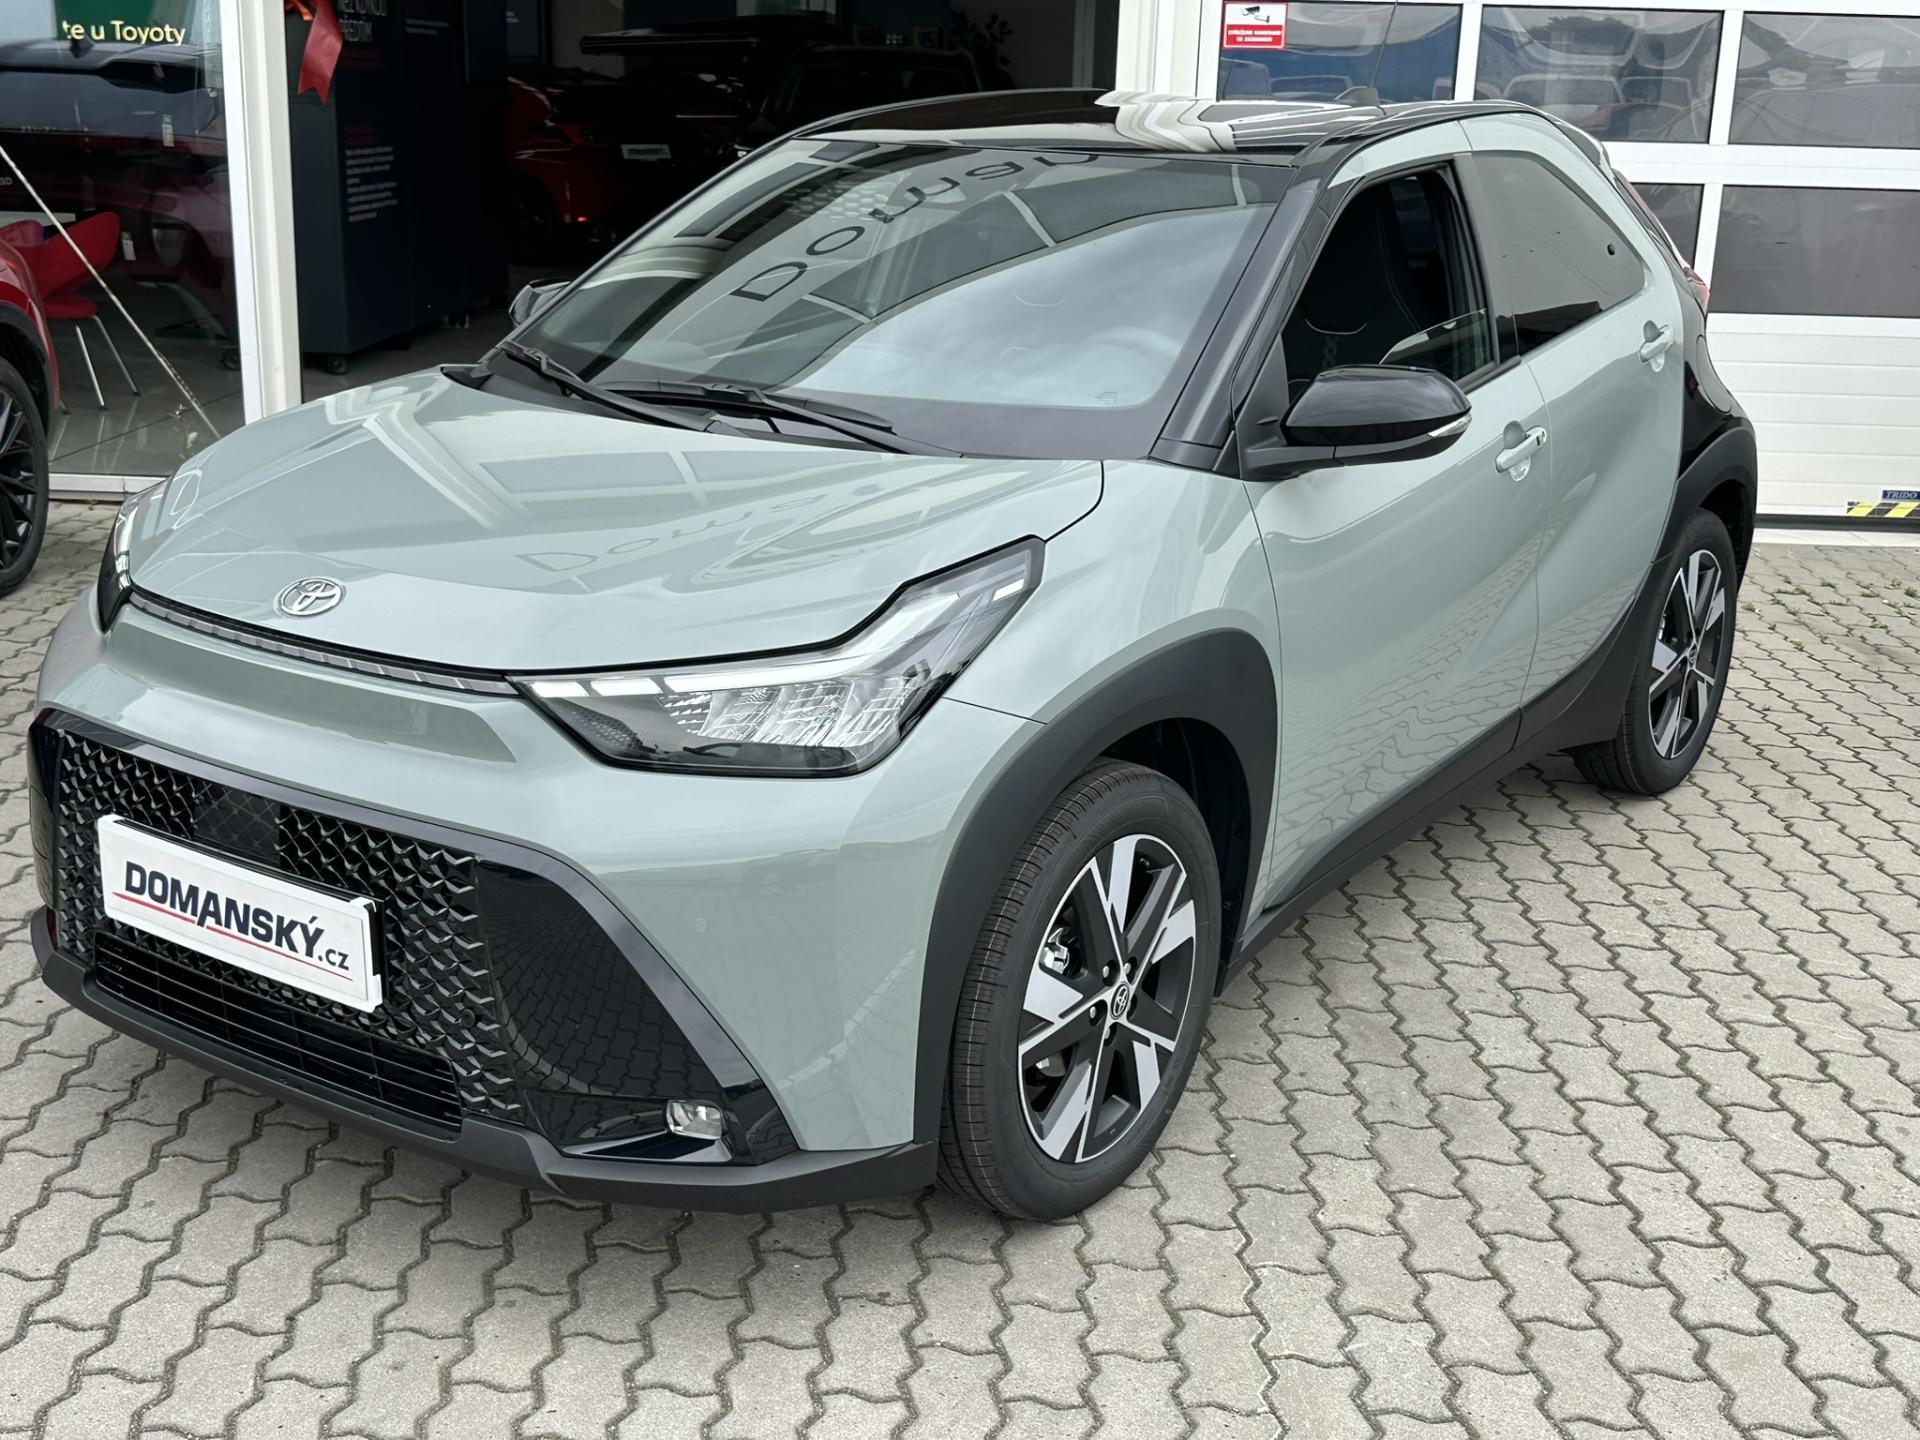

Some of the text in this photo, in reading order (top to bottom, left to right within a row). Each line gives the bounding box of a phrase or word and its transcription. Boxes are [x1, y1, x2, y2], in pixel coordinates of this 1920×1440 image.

[90, 25, 105, 40] u
[110, 20, 186, 46] Toyoty
[1886, 491, 1918, 499] TRIDO
